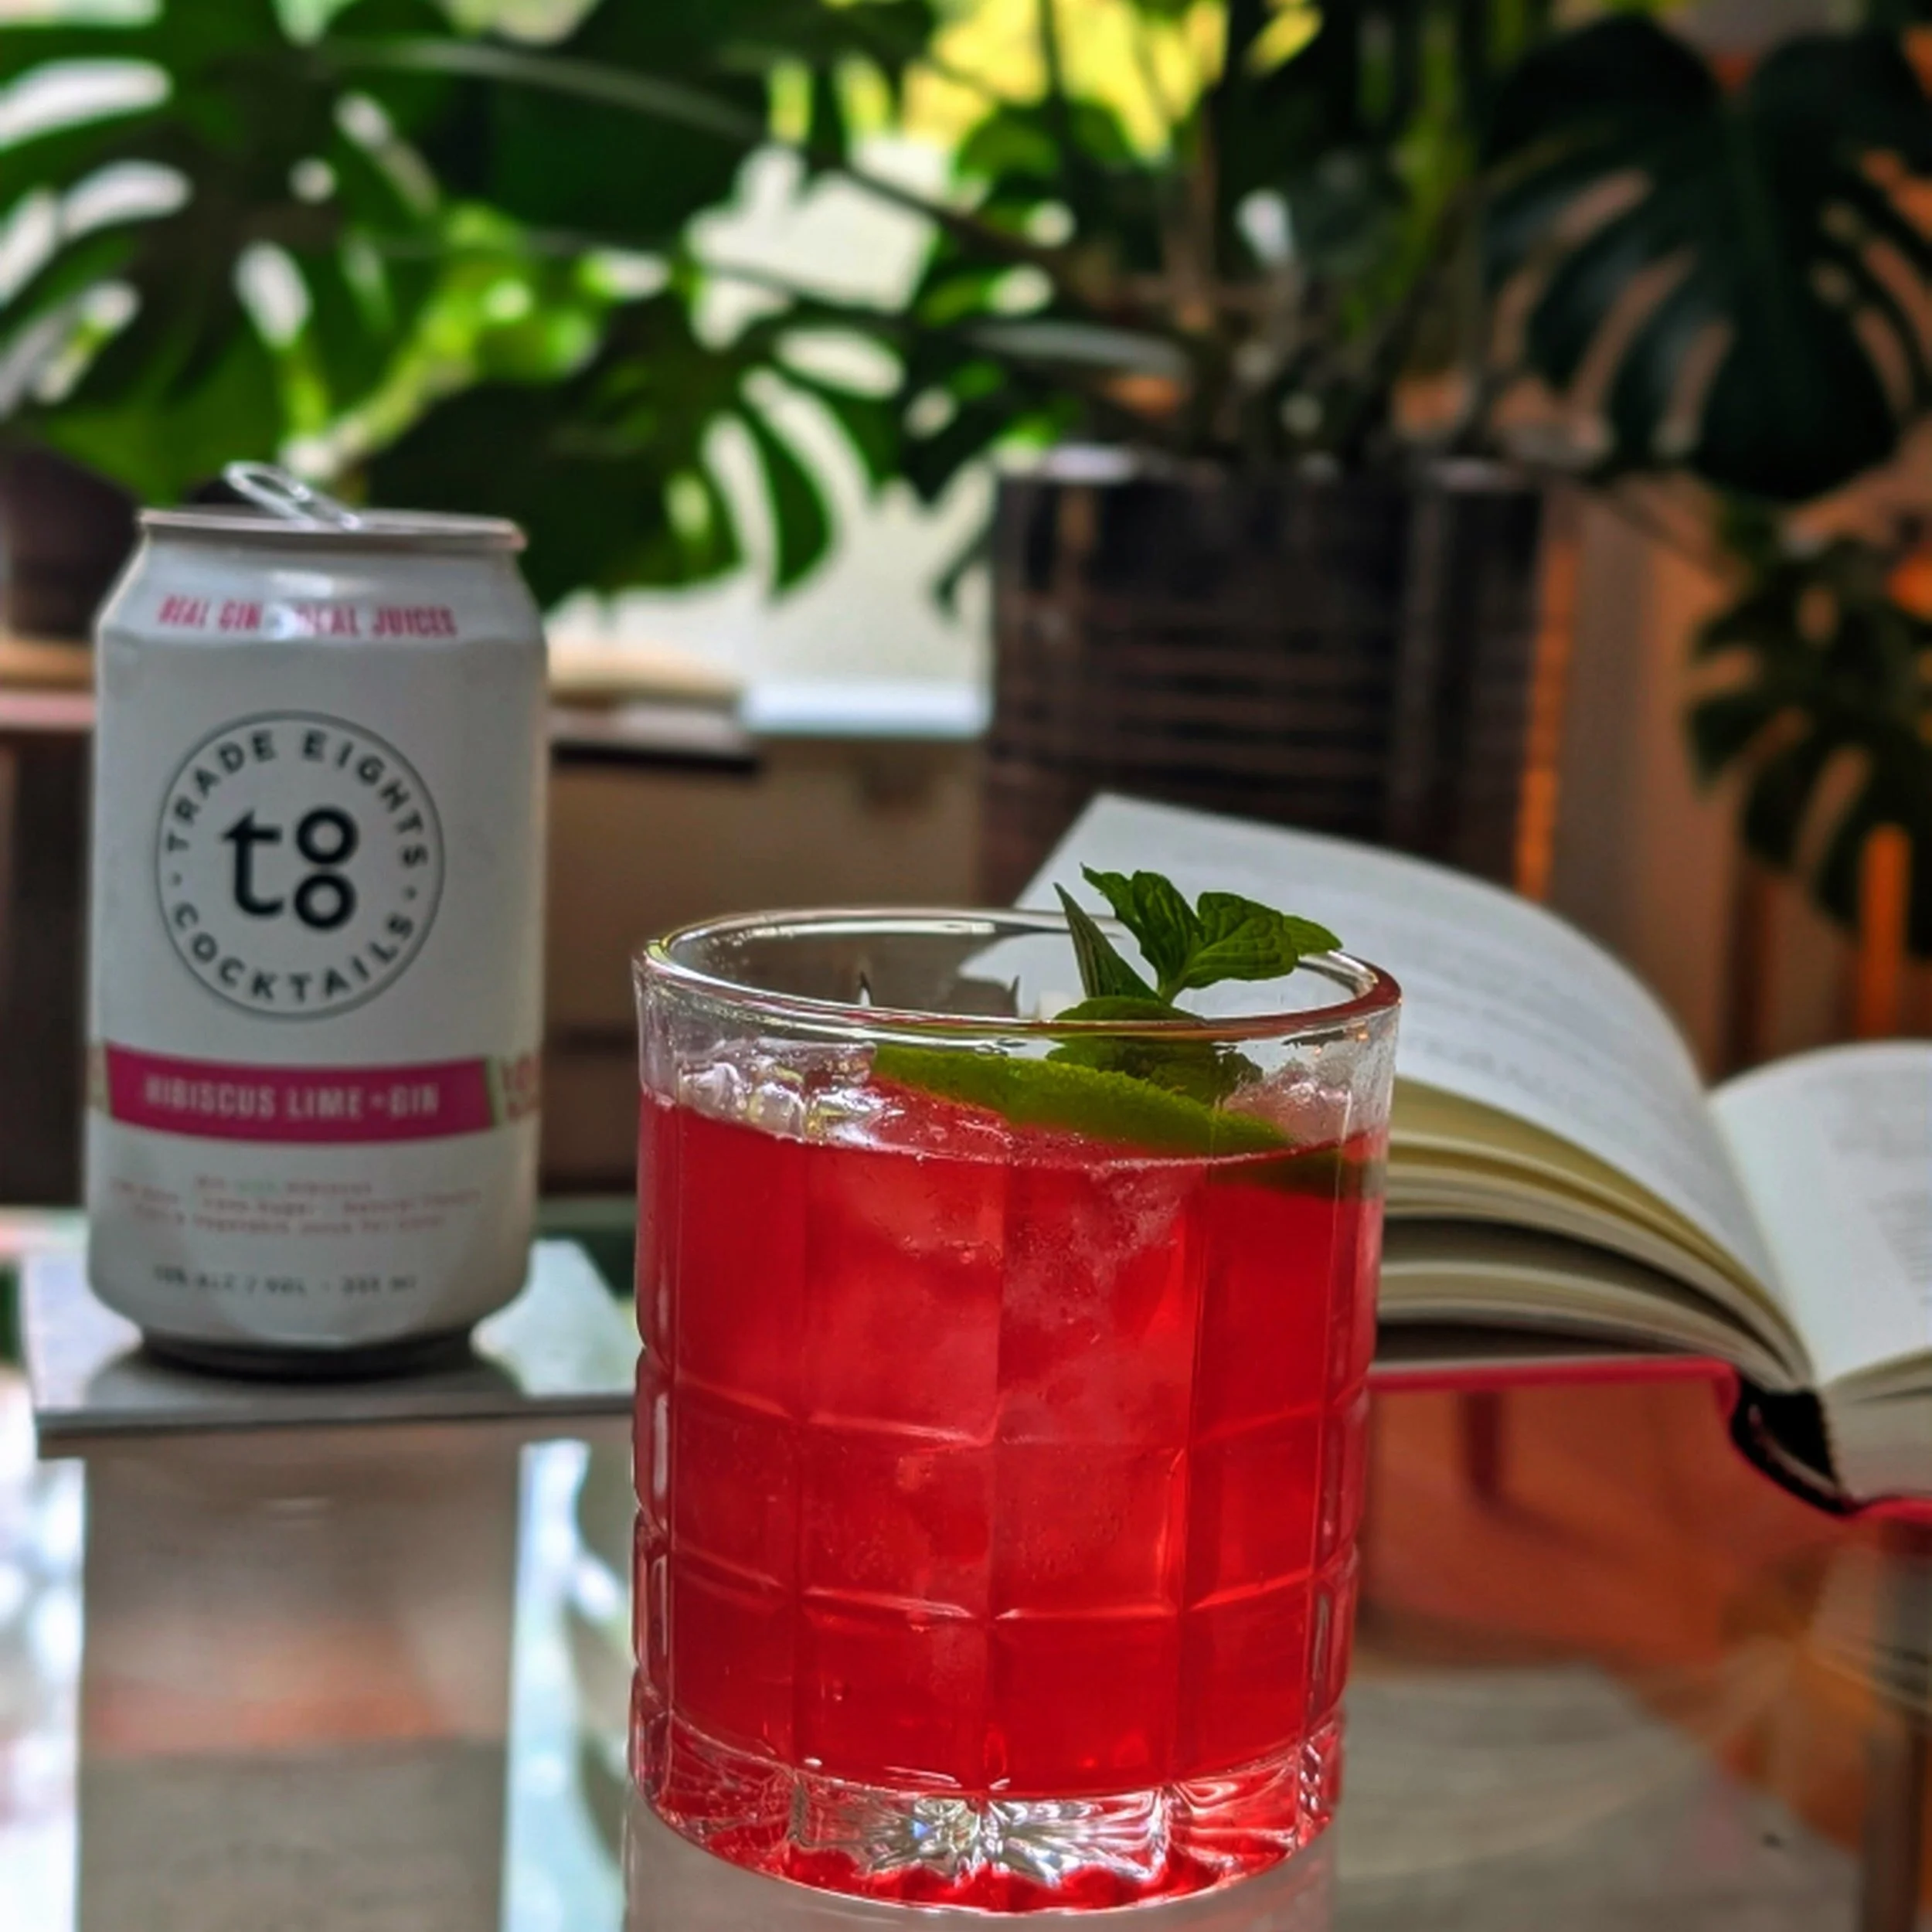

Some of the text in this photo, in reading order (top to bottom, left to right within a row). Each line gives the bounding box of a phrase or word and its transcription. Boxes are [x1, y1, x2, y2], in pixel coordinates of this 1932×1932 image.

[158, 594, 212, 629] REAL
[218, 598, 264, 632] GIN
[372, 606, 457, 638] JUICES
[167, 729, 428, 869] TRADE EIGHTS
[173, 903, 414, 1002] COCKTAILS
[144, 1073, 277, 1121] HIBISCUS
[286, 1084, 363, 1121] LIME
